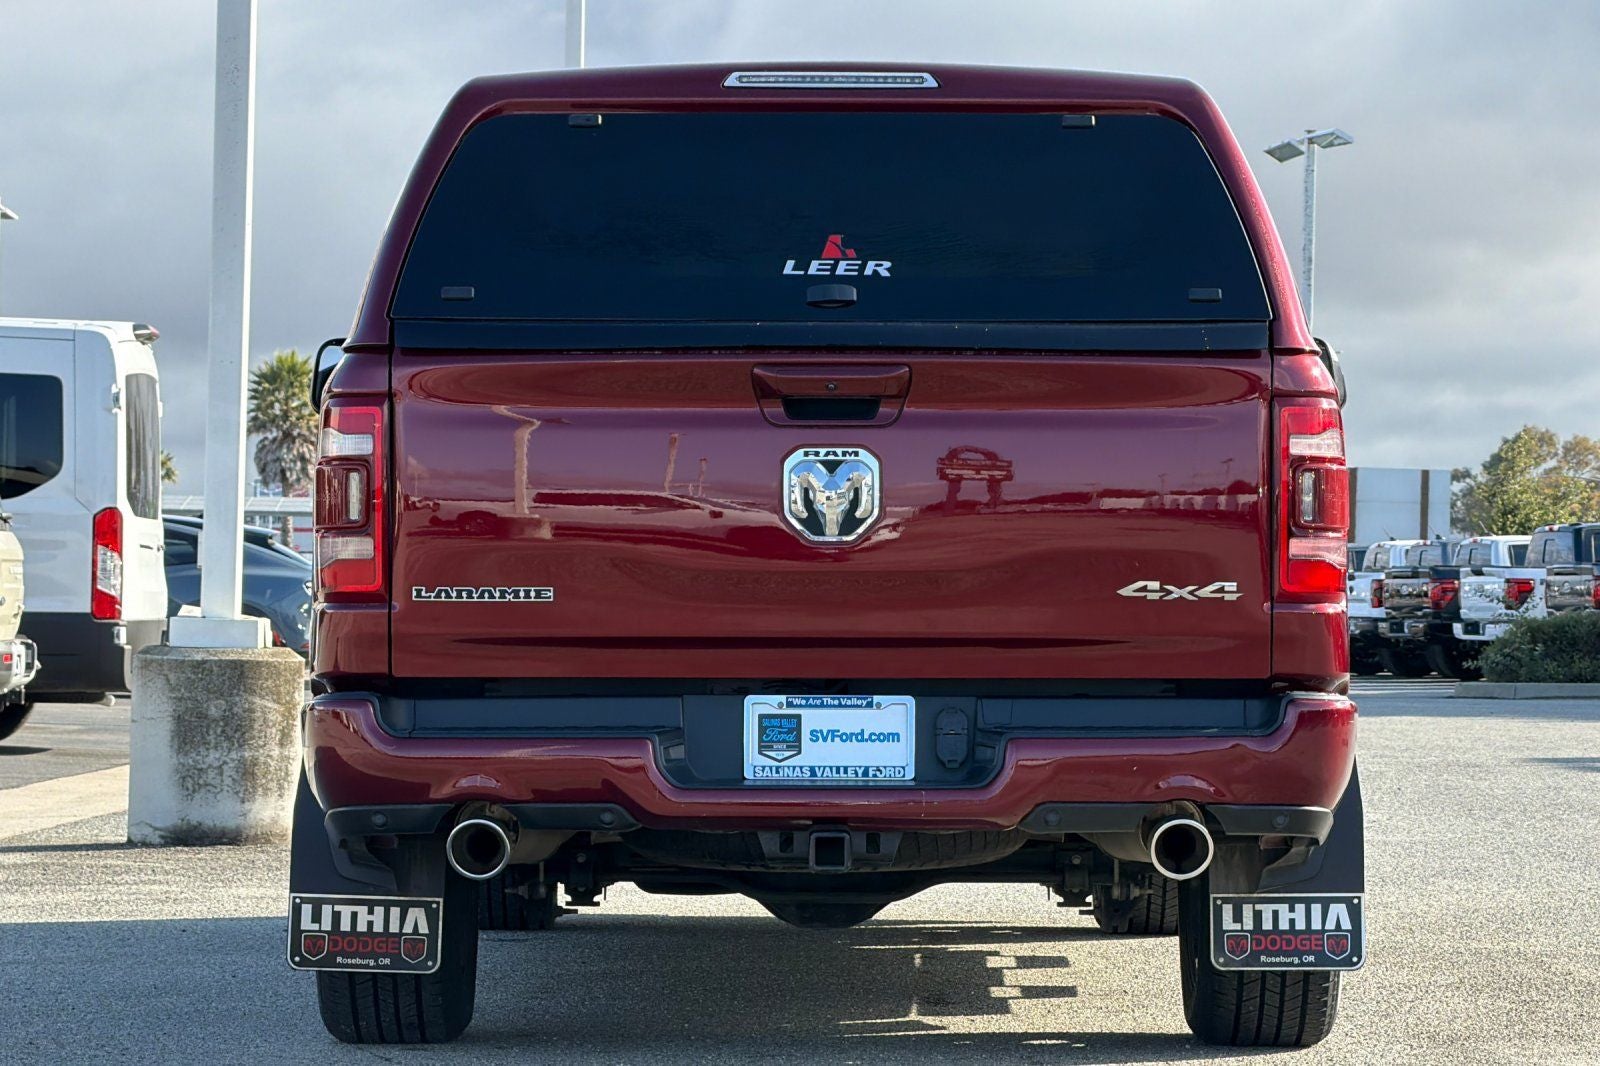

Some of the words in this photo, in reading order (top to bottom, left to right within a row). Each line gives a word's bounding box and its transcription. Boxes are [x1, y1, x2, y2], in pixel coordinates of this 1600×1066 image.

[782, 260, 893, 277] LEER
[803, 450, 860, 458] RAM
[412, 586, 554, 601] LARAMIE
[1116, 580, 1244, 601] 4x4
[807, 697, 821, 706] Are
[823, 697, 839, 706] The
[762, 727, 797, 742] Ford
[809, 729, 901, 743] SVFord.com
[754, 766, 812, 778] SALINAS
[815, 766, 865, 778] VALLEY
[868, 766, 905, 778] FORD
[300, 903, 430, 934] LITHIA
[1222, 903, 1353, 930] LITHIA
[328, 934, 400, 954] DODGE
[1252, 934, 1324, 951] DODGE
[336, 956, 377, 966] Roseburg,
[378, 957, 391, 965] OR
[1260, 955, 1301, 964] Roseburg,
[1302, 955, 1316, 963] OR
